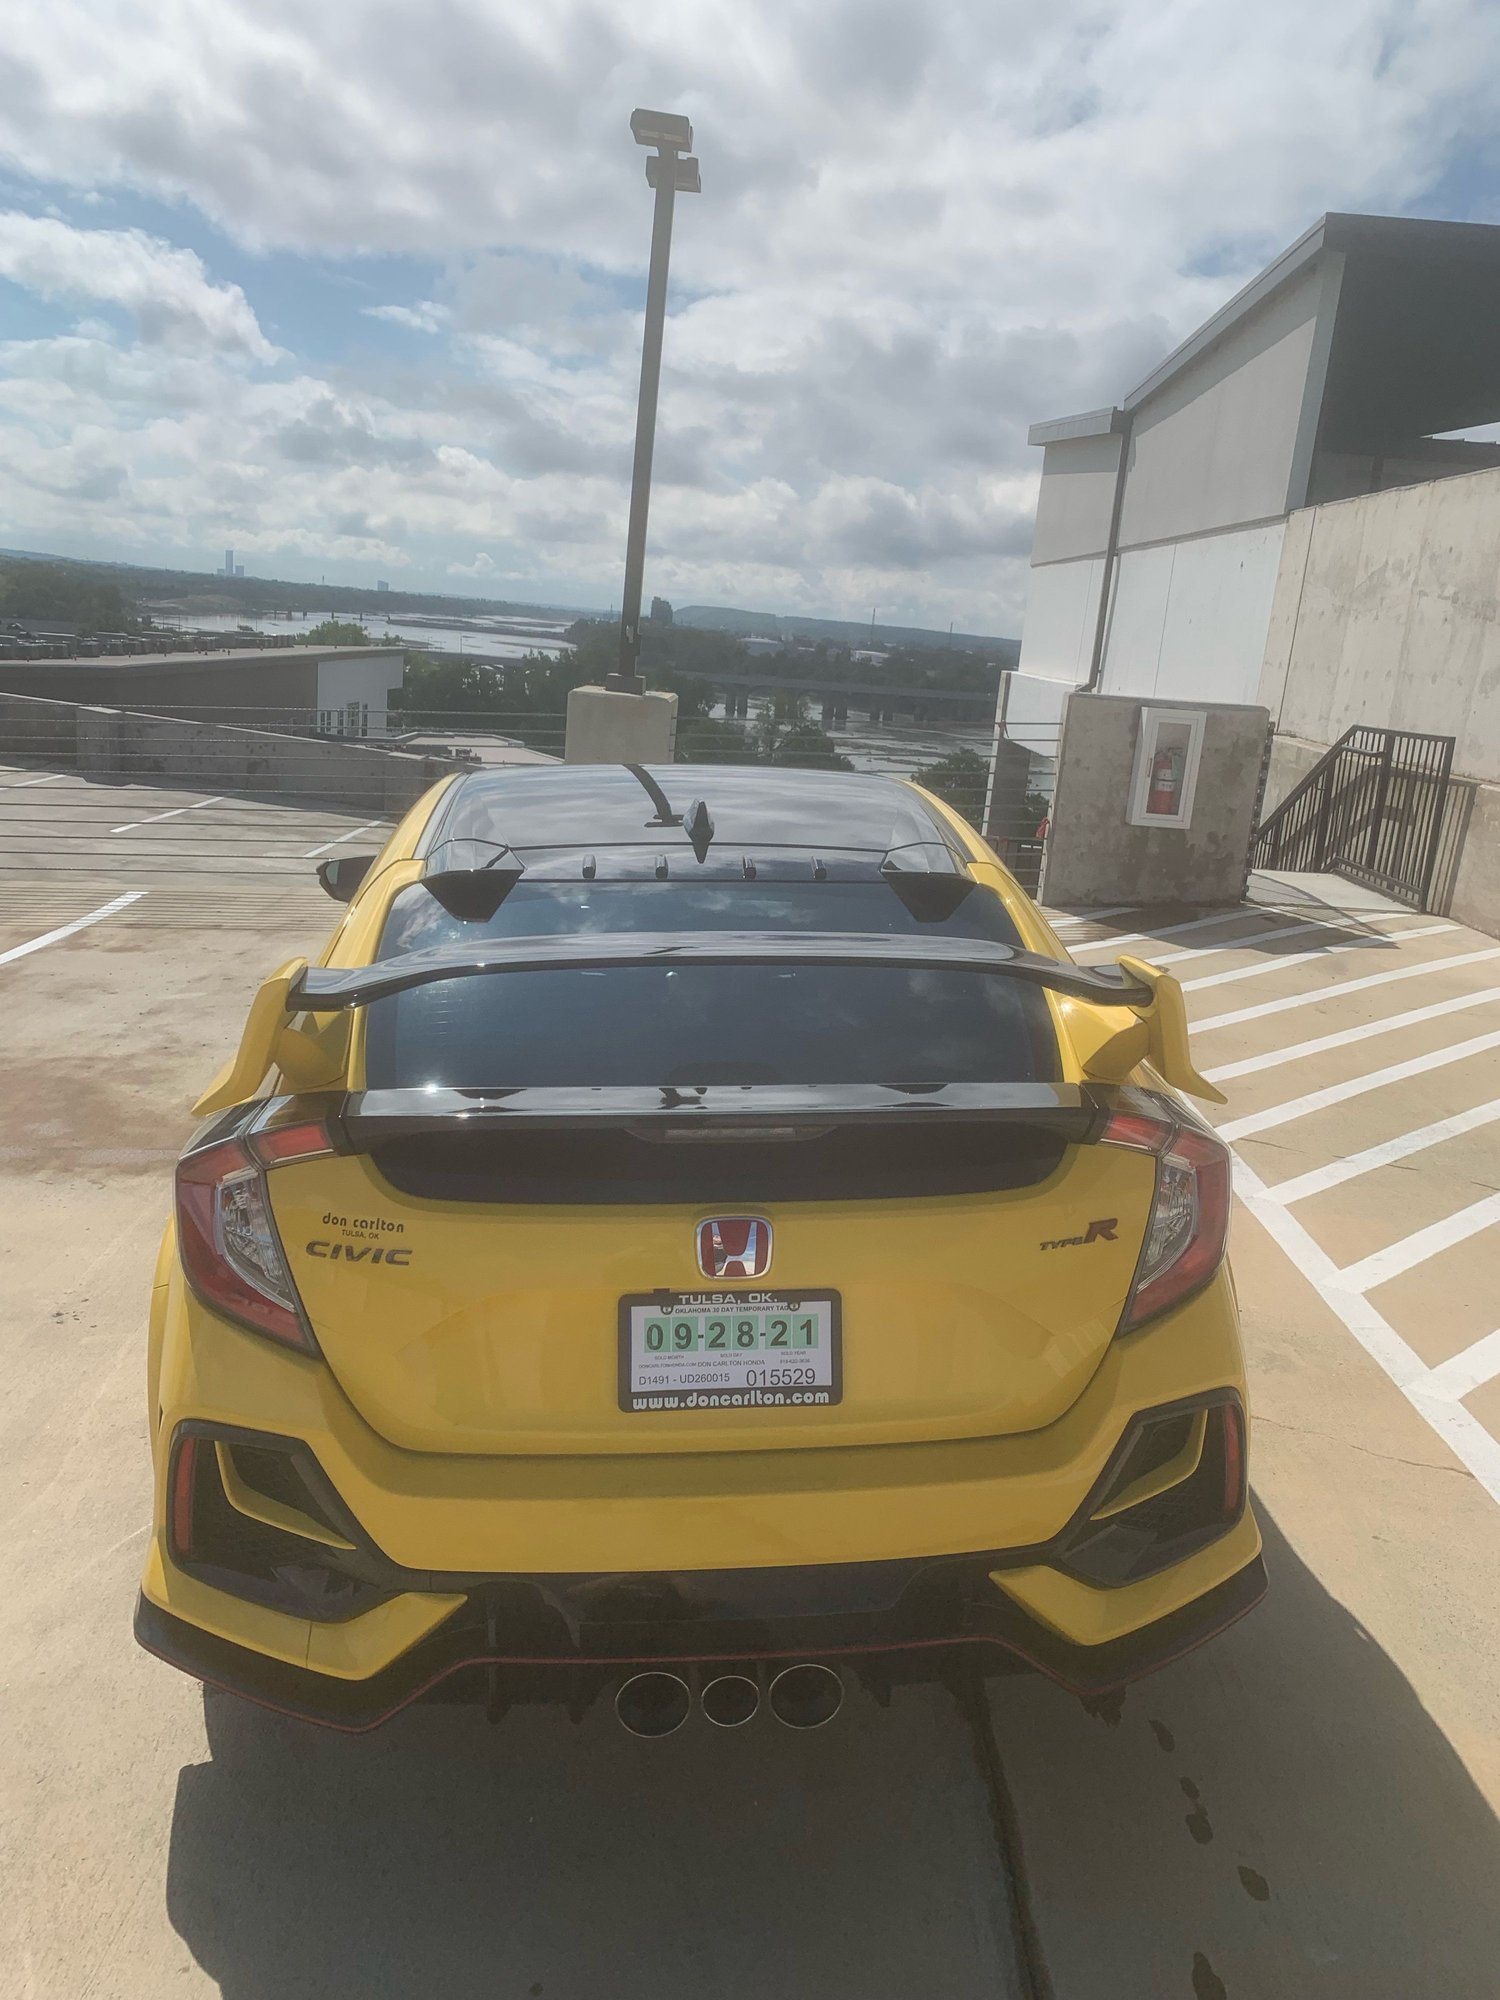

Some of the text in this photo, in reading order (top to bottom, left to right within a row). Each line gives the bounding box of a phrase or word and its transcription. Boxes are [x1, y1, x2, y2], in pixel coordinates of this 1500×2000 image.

[322, 1212, 404, 1233] don carlton
[368, 1232, 380, 1241] OK
[305, 1240, 413, 1266] CIVIC
[678, 1293, 778, 1306] TULSA, OK.
[646, 1319, 813, 1351] 09-28-21
[712, 1359, 742, 1367] CARLTON
[743, 1359, 766, 1367] HONDA
[638, 1374, 670, 1385] D1491
[678, 1373, 731, 1384] UD260015
[746, 1368, 816, 1387] 015529
[632, 1389, 830, 1411] www.doncarlton.com
